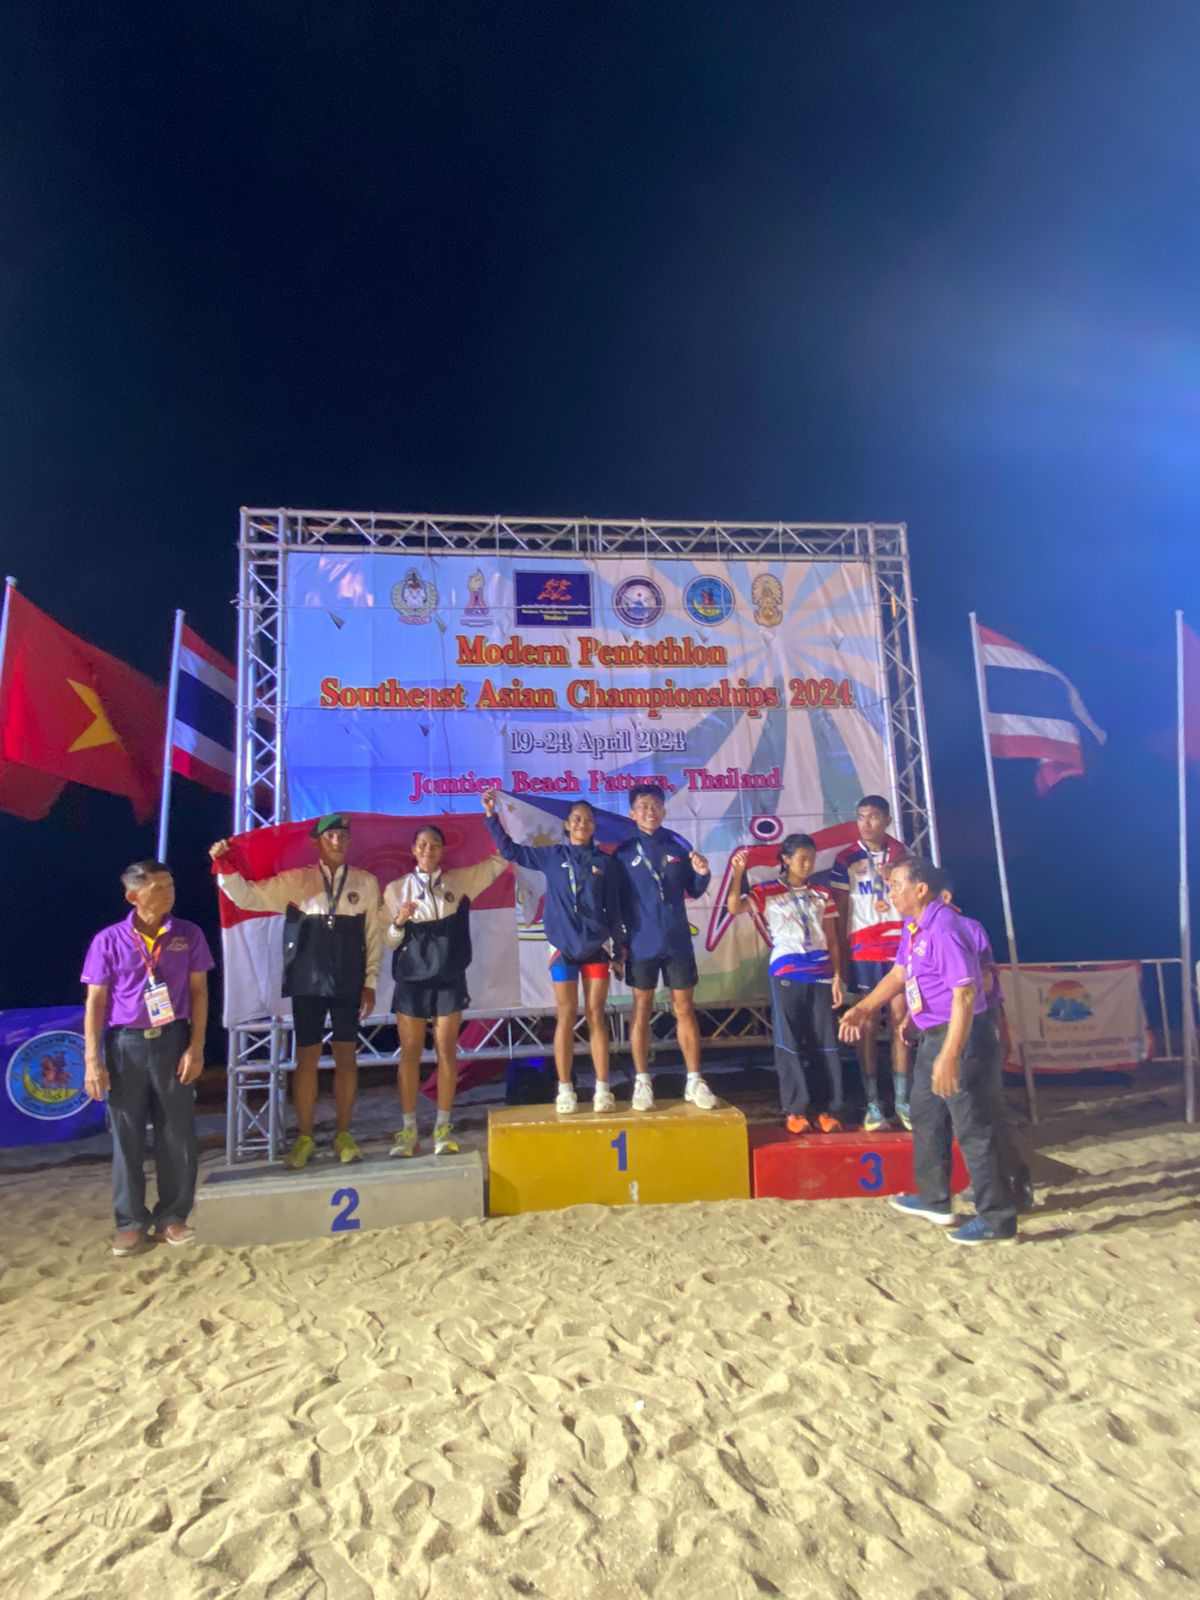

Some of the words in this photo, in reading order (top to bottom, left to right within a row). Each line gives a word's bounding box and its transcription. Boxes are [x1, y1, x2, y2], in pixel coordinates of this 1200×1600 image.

[455, 635, 570, 667] Modern
[578, 636, 728, 667] Pentathlon
[320, 677, 467, 709] Southeast
[475, 678, 558, 709] Asian
[566, 678, 780, 718] Championships
[788, 677, 854, 709] 2024
[508, 729, 573, 753] 19-24
[577, 728, 631, 759] April
[637, 729, 687, 752] 2024
[408, 771, 503, 802] Jomtien
[511, 770, 580, 794] Beach
[683, 767, 783, 792] Thailand
[610, 1130, 628, 1172] 1
[859, 1152, 884, 1192] 3
[330, 1186, 361, 1233] 2
